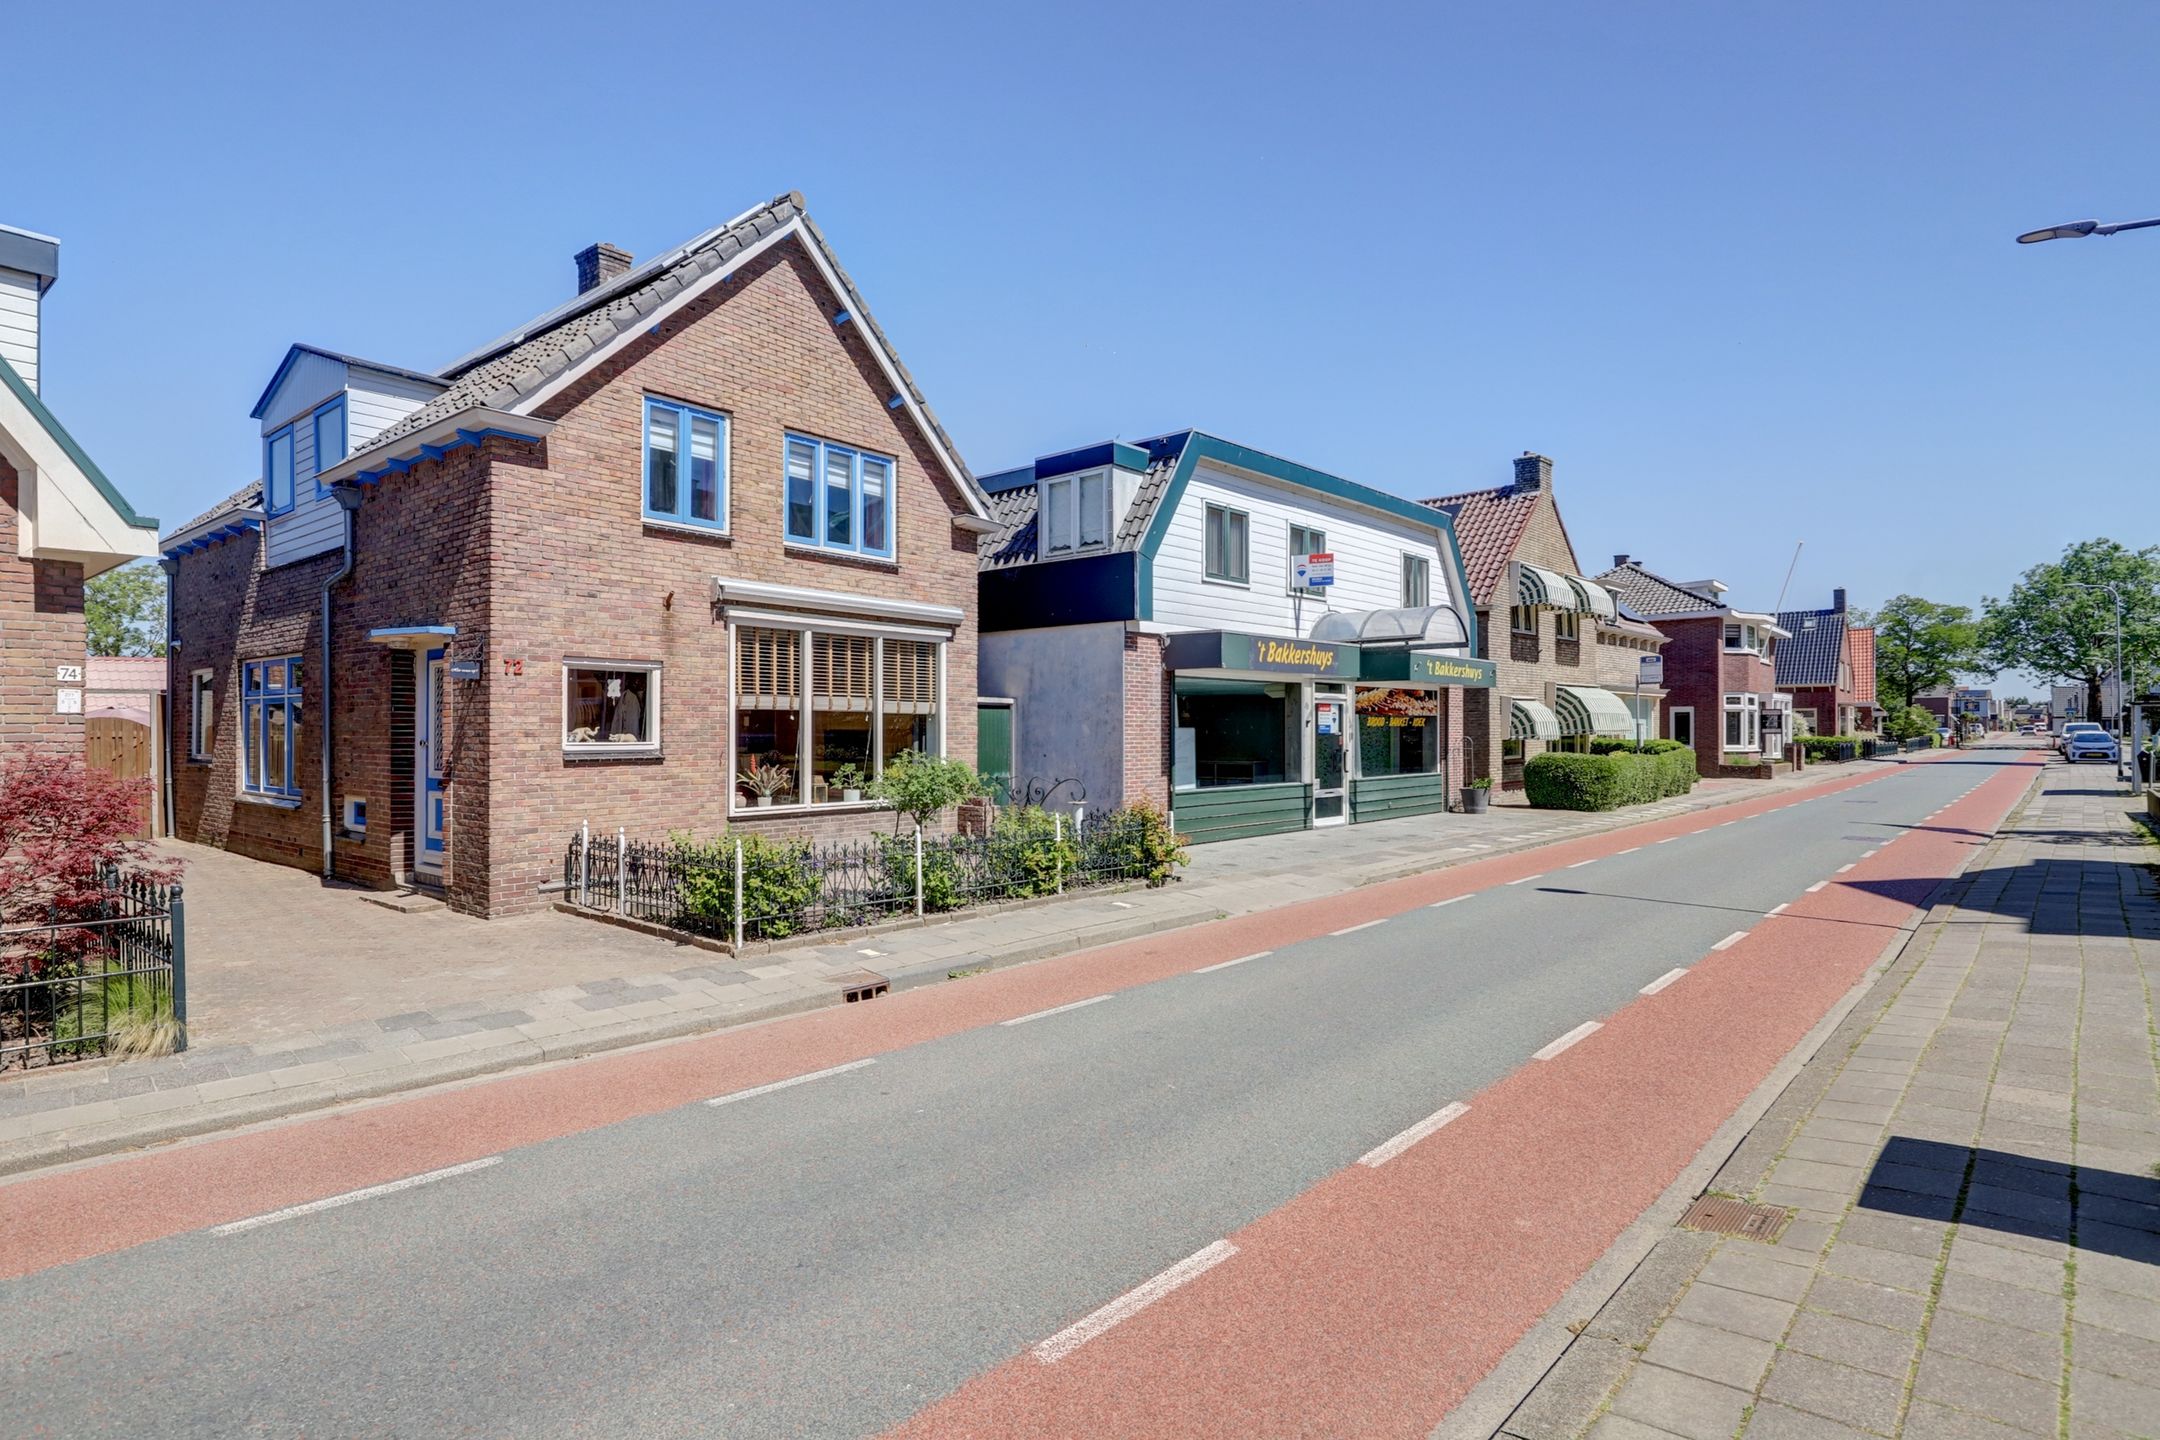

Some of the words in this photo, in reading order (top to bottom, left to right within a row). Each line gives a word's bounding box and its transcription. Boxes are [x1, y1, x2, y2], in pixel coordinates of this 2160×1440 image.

[1267, 641, 1333, 671] Bakkershuys
[60, 667, 78, 679] 74
[504, 659, 523, 676] 72
[1434, 661, 1482, 682] Bakkershuys
